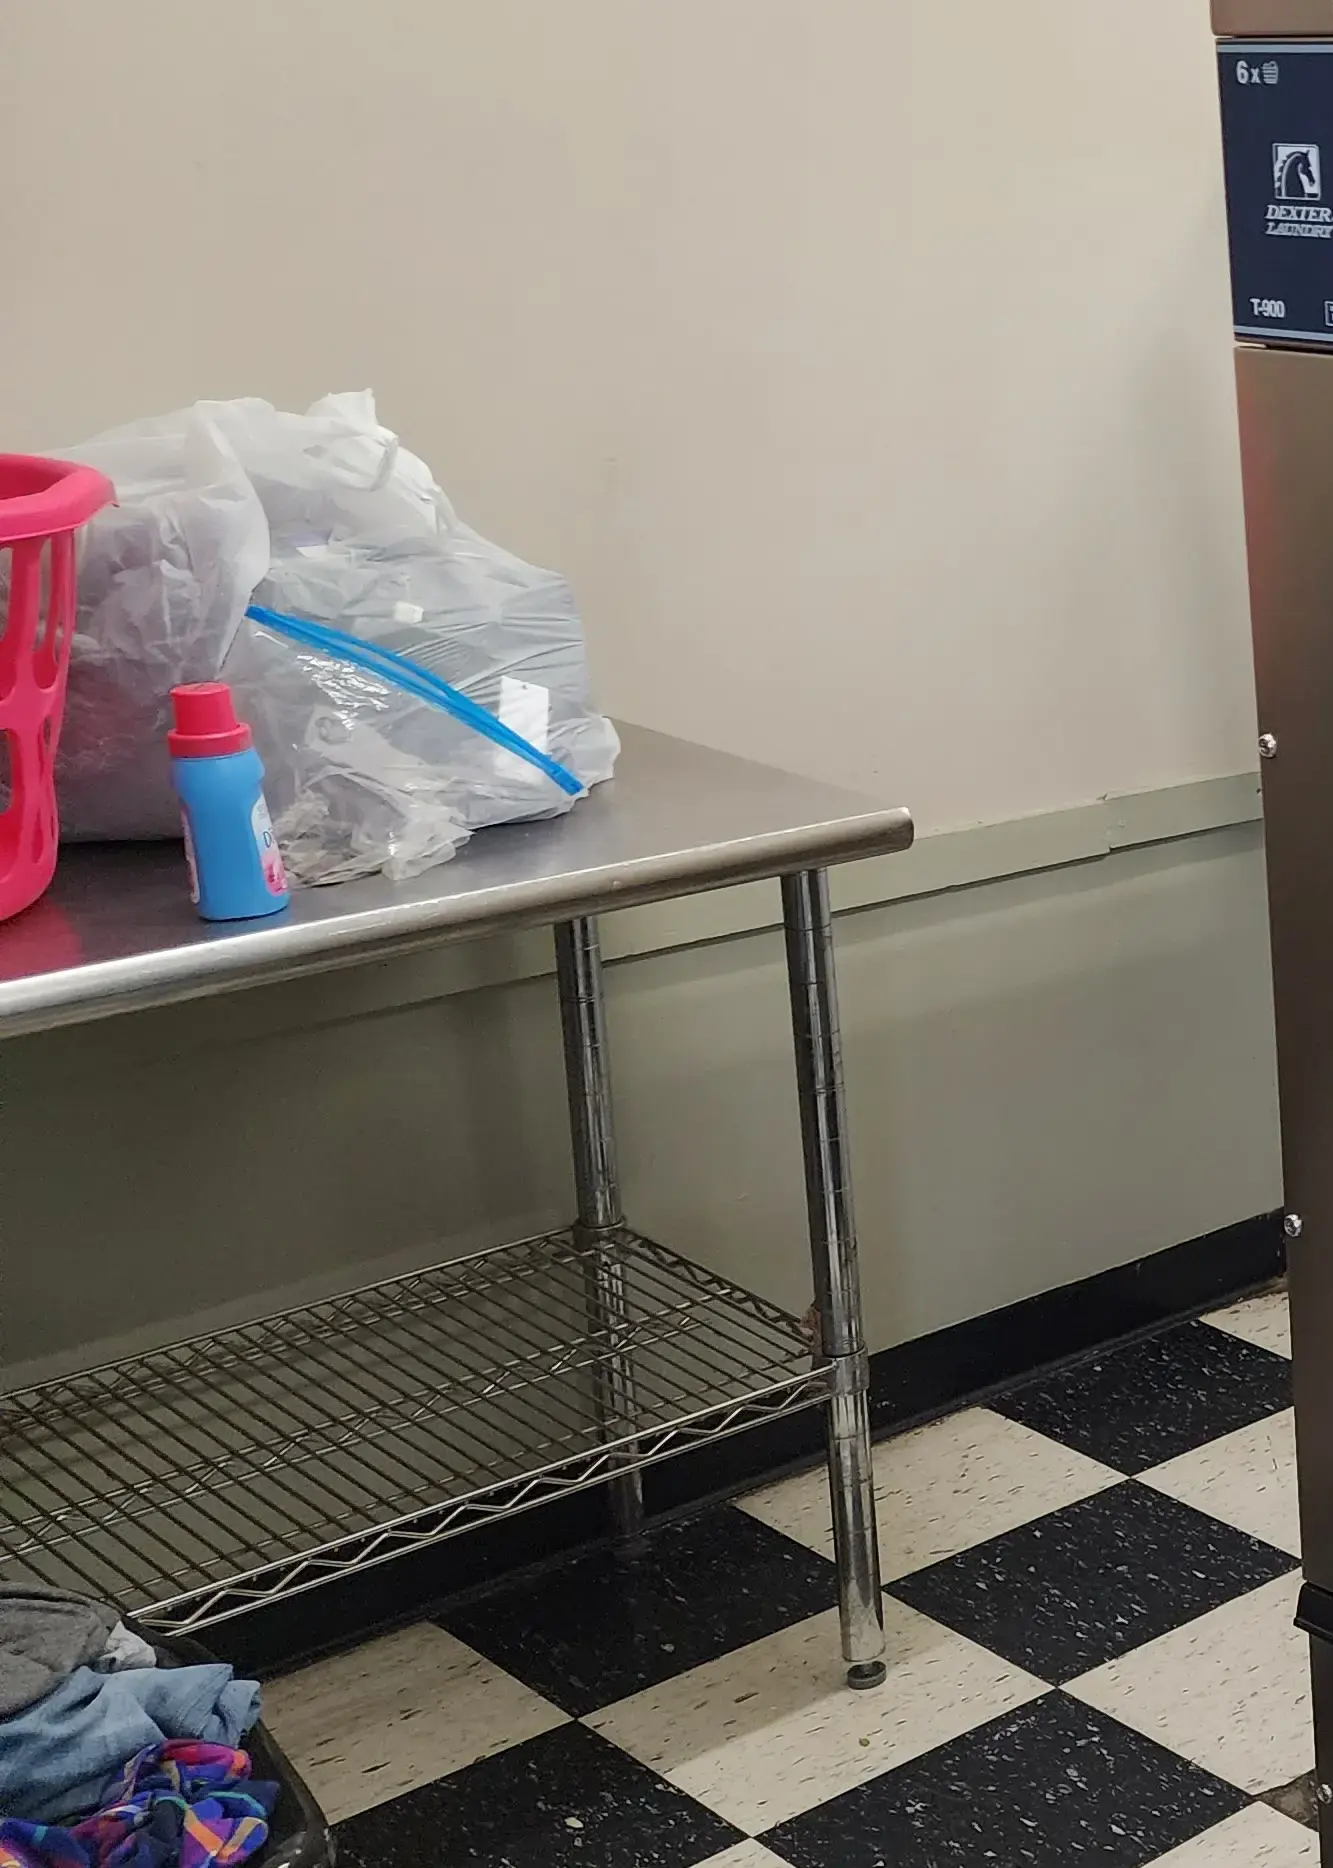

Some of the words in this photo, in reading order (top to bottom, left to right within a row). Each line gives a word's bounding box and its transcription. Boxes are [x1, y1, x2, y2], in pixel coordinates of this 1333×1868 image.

[1236, 60, 1248, 85] 6
[1264, 204, 1333, 222] DEXTER
[1249, 298, 1285, 318] T-900
